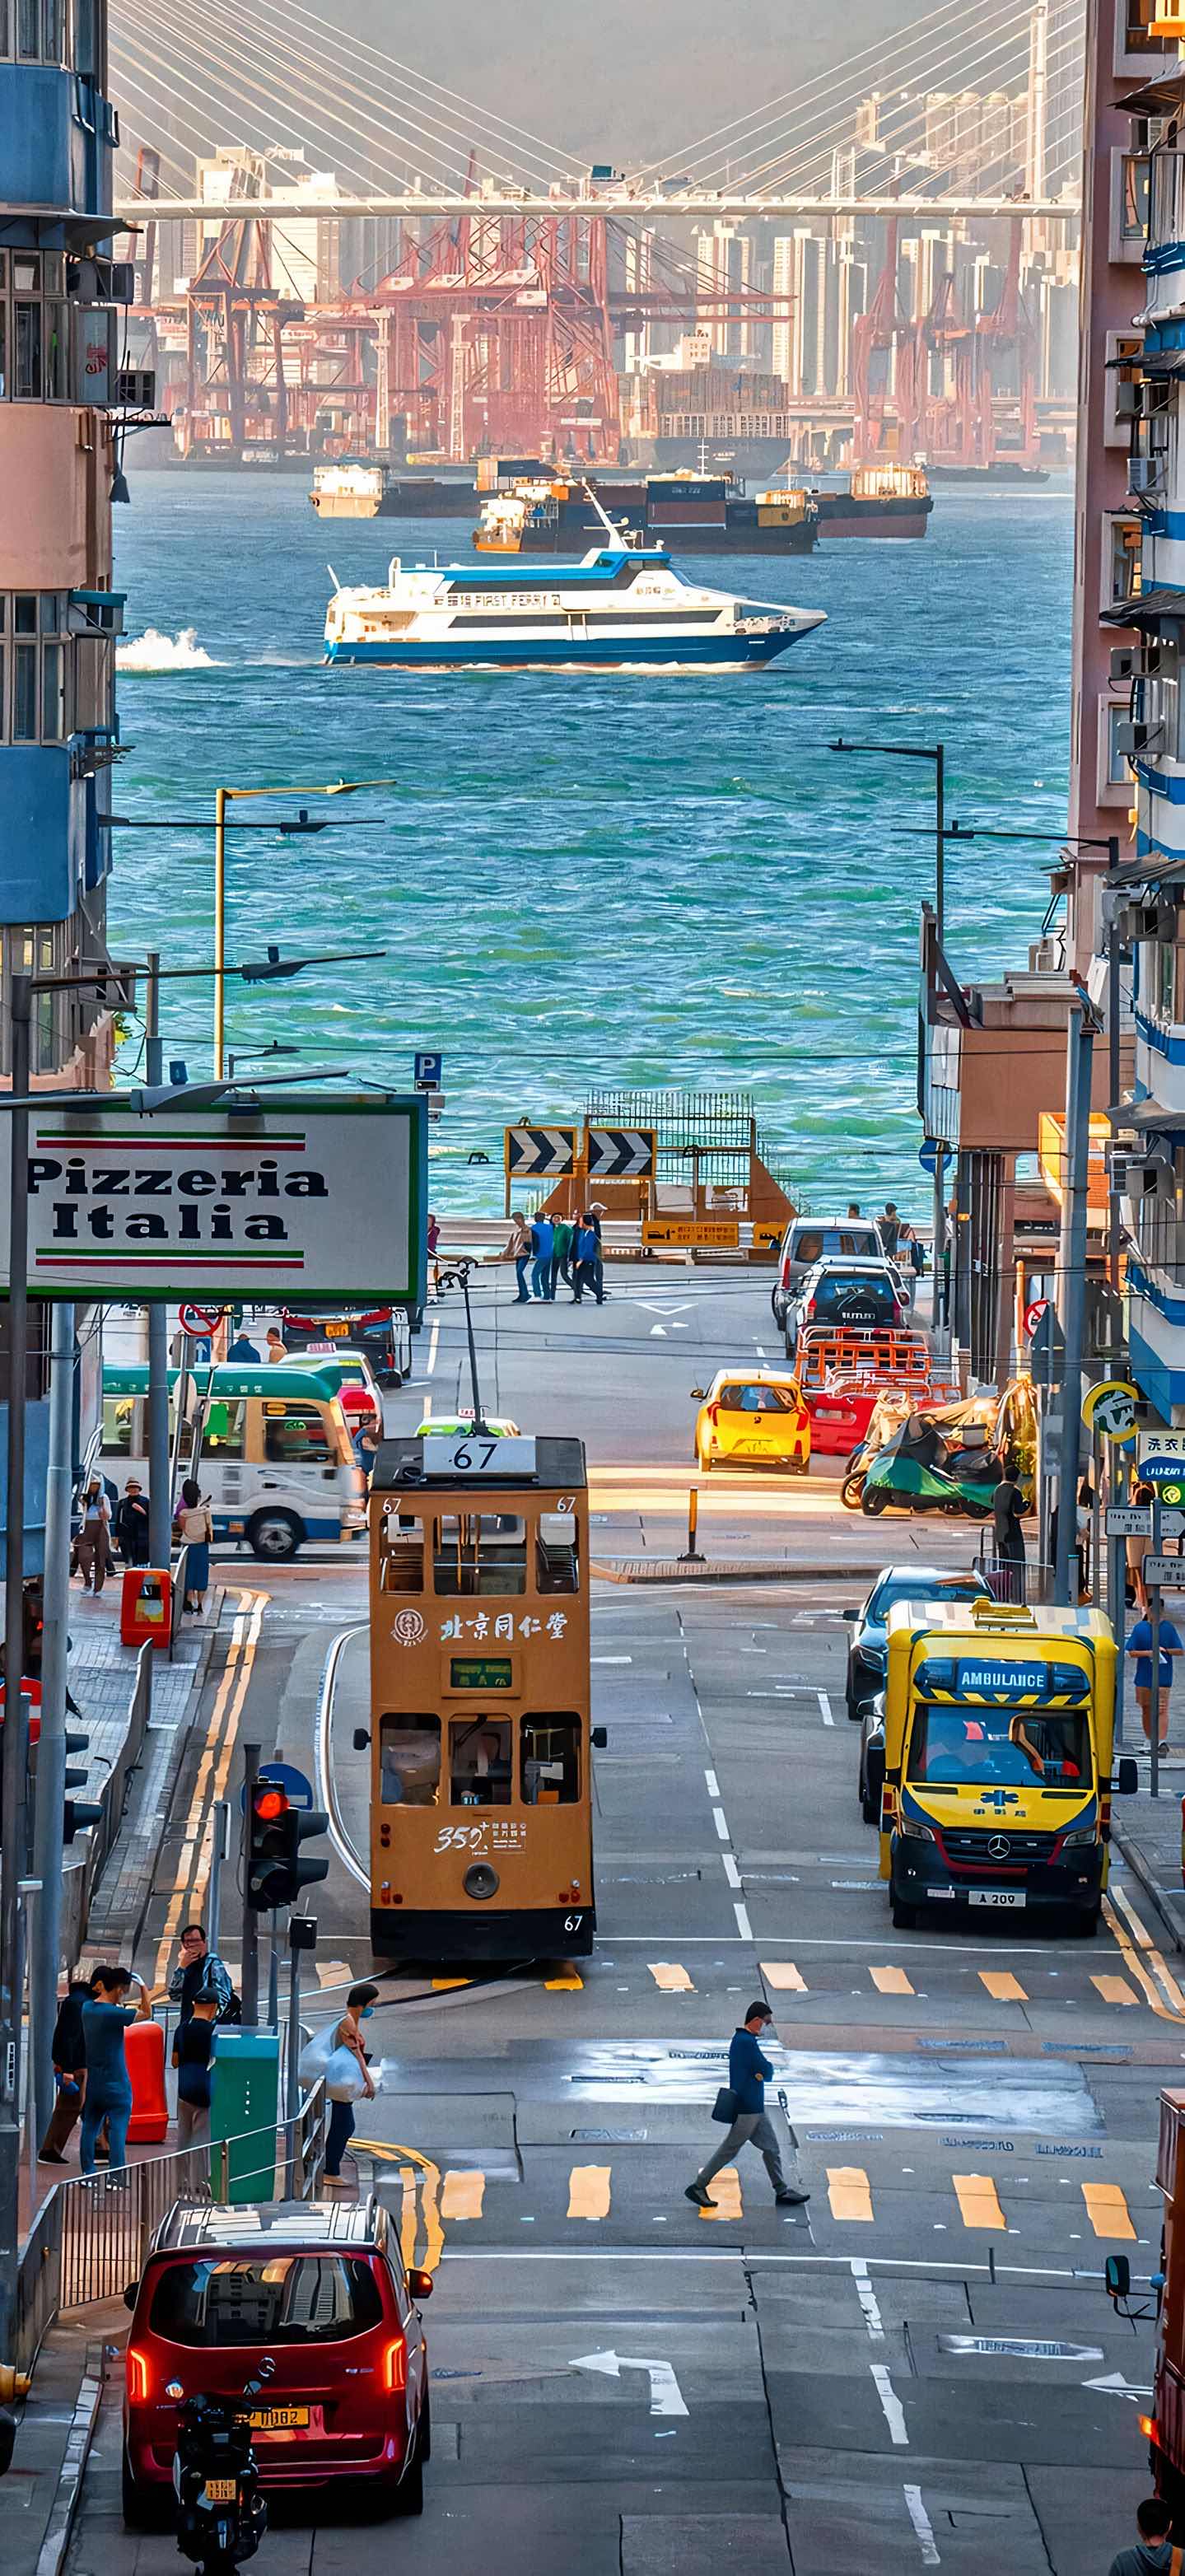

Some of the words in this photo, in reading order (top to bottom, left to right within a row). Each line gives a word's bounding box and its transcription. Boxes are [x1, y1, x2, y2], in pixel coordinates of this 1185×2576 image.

[418, 1057, 436, 1077] P
[27, 1158, 329, 1197] Pizzeria
[52, 1202, 289, 1240] Italia
[453, 1443, 498, 1470] 67
[382, 1497, 402, 1514] 67
[557, 1496, 576, 1513] 67
[961, 1672, 1045, 1687] AMBULANCE
[991, 1894, 1015, 1904] 209
[564, 1914, 583, 1932] 67
